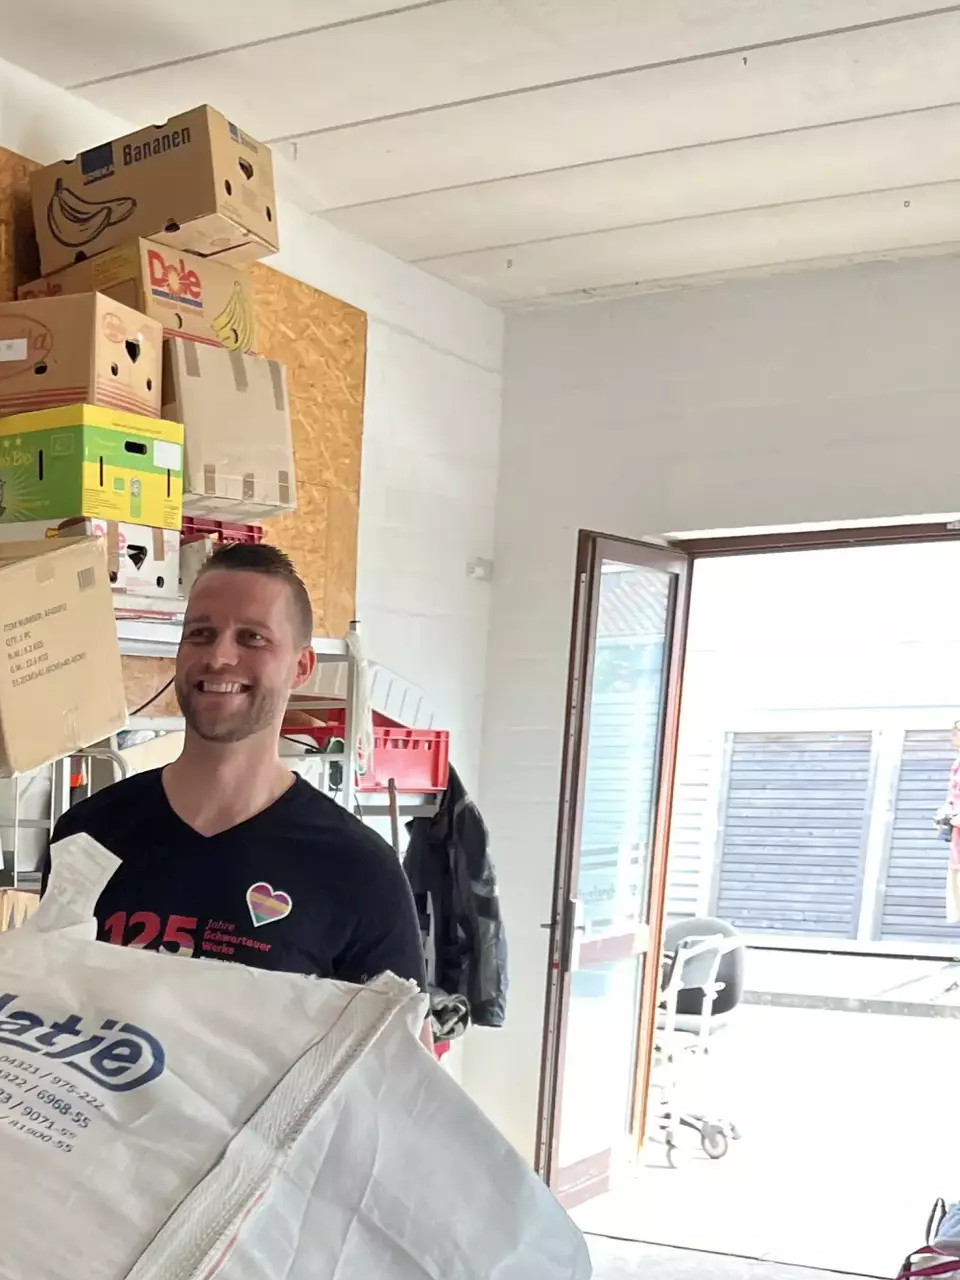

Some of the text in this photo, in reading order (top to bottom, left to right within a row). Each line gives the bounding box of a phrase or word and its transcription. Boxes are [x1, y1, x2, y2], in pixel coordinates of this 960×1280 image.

[123, 126, 191, 166] Bananen
[147, 249, 202, 300] Dole
[104, 911, 199, 958] 125
[203, 930, 273, 952] Schwartauer
[206, 918, 236, 932] Jahre
[202, 941, 236, 956] Werke
[36, 1089, 93, 1129] 6968-55
